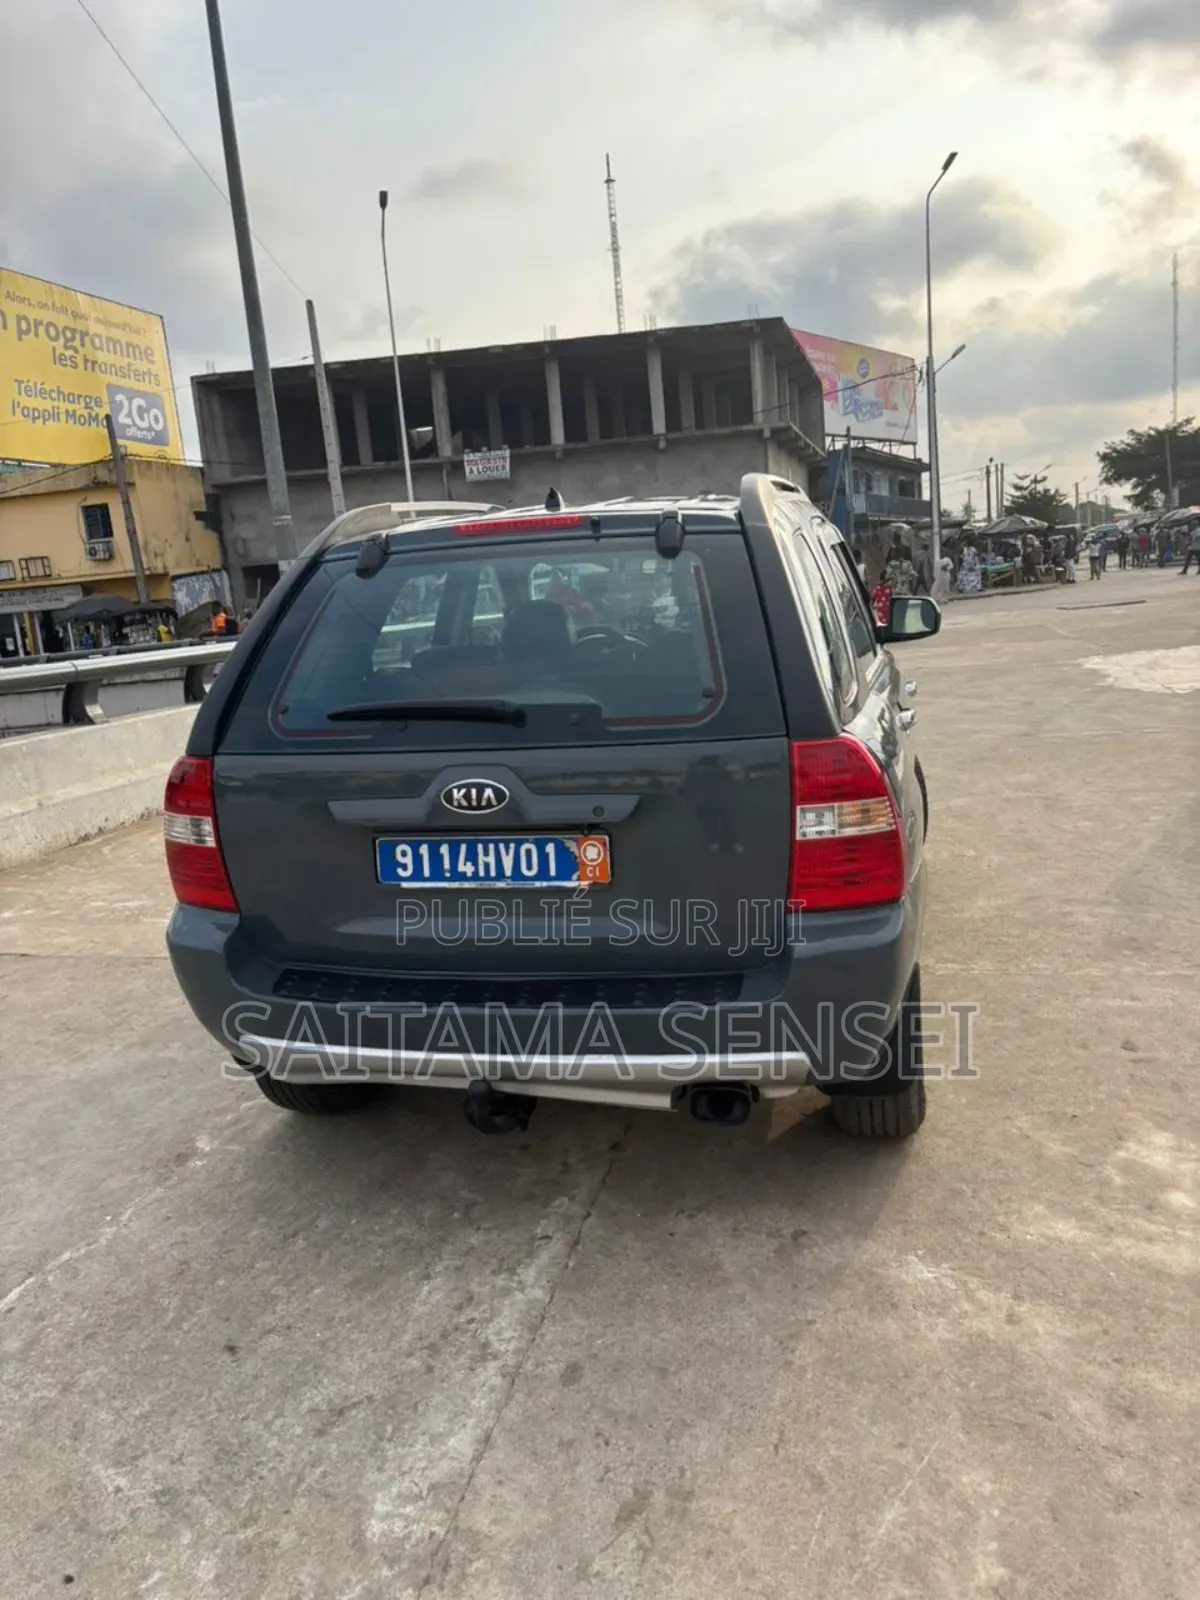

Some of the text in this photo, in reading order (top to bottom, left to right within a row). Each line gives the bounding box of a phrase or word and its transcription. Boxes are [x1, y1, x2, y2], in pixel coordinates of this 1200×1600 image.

[4, 290, 36, 309] Alors,
[37, 302, 49, 311] on
[52, 302, 69, 316] fait
[15, 313, 156, 365] programme
[52, 347, 161, 387] les transferts
[14, 379, 103, 411] Télécharge
[11, 399, 61, 426] l'appli
[114, 393, 165, 431] 2Go
[452, 787, 498, 807] KIA
[395, 842, 557, 878] 9114HV01
[586, 866, 600, 878] CI
